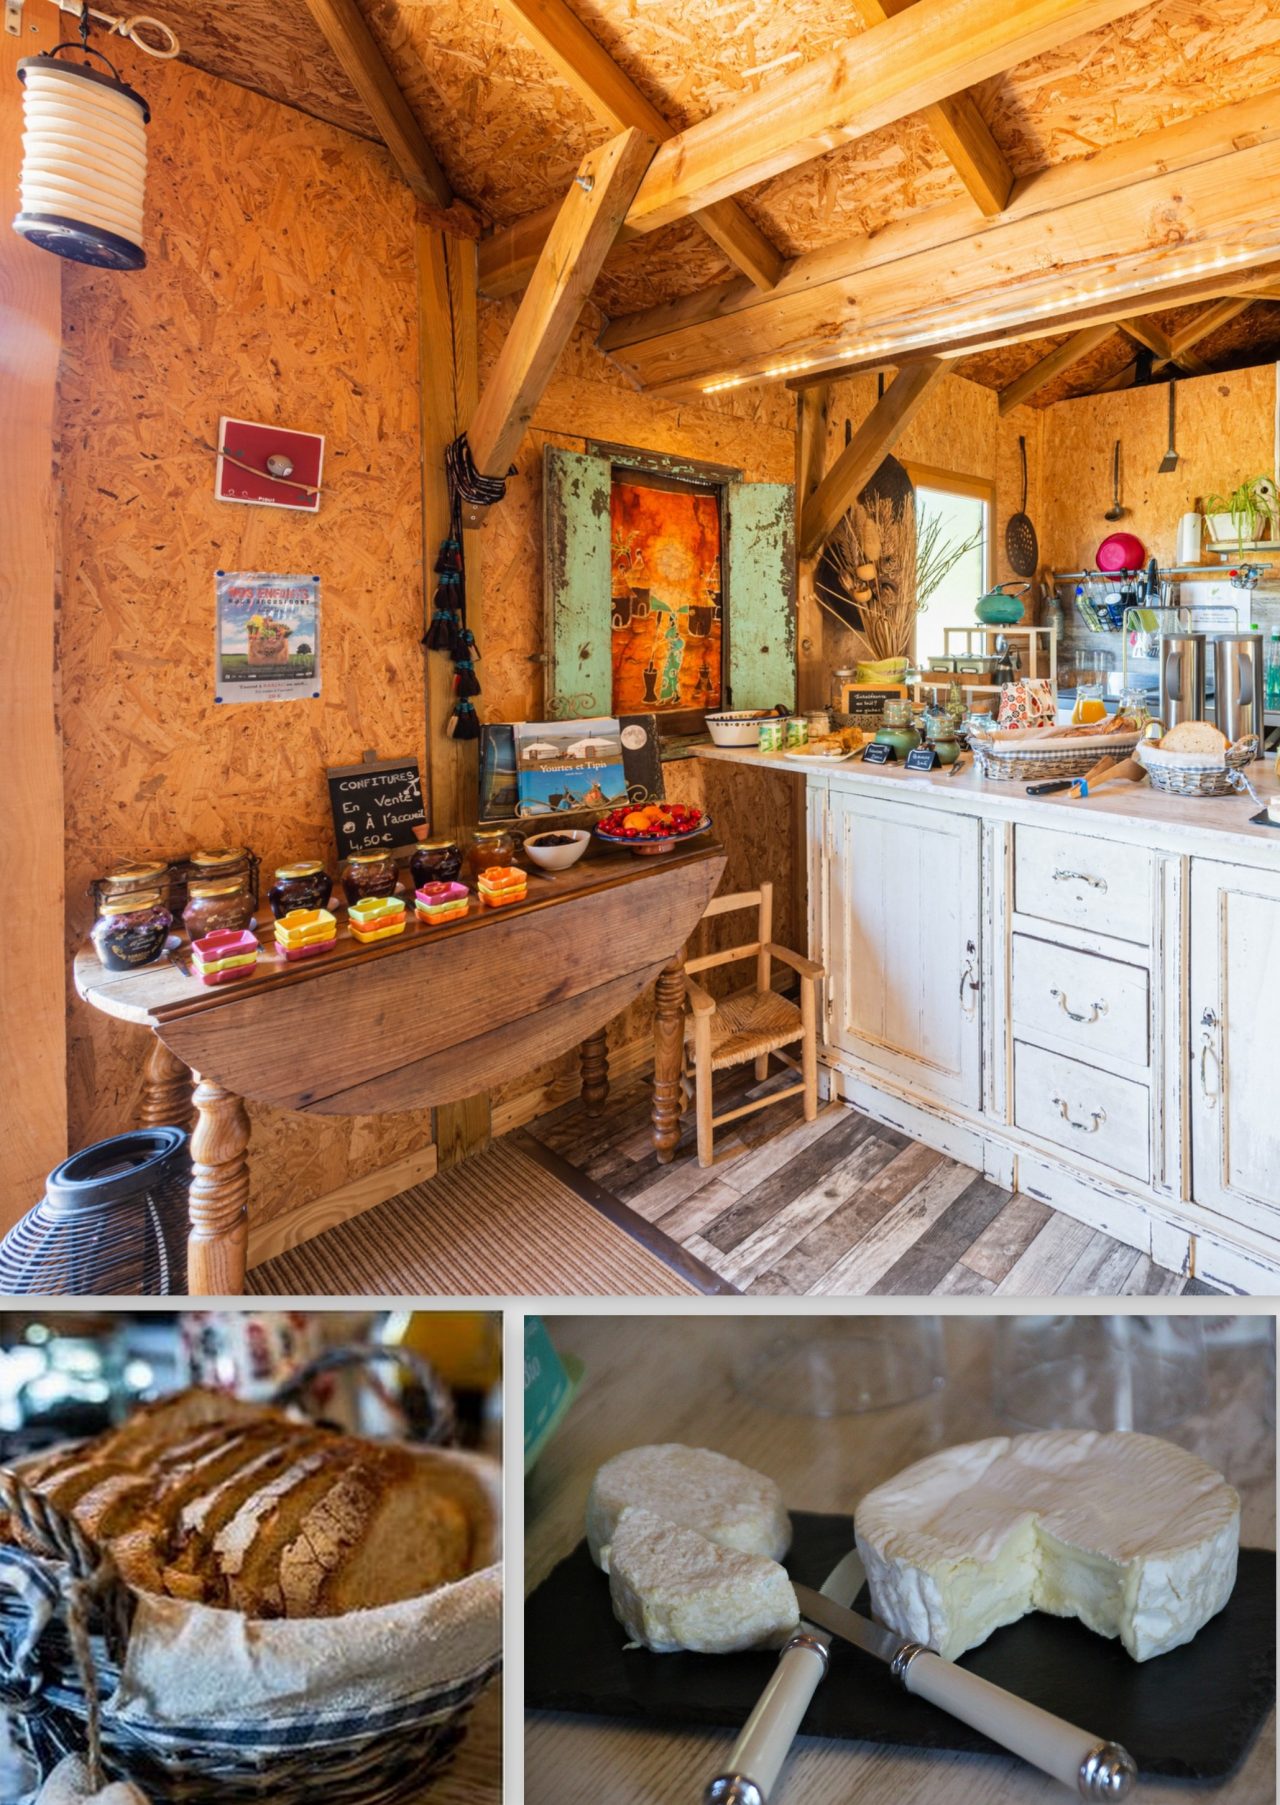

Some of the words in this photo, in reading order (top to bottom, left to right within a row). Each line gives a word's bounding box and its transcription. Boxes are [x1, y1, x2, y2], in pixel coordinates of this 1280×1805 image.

[540, 764, 573, 773] Yourtes
[575, 763, 584, 771] et
[585, 761, 607, 771] Tipis
[339, 771, 415, 791] CONFITURES
[342, 801, 360, 814] En
[374, 792, 413, 807] Vente
[366, 812, 375, 830] À
[383, 808, 426, 827] l'accueil
